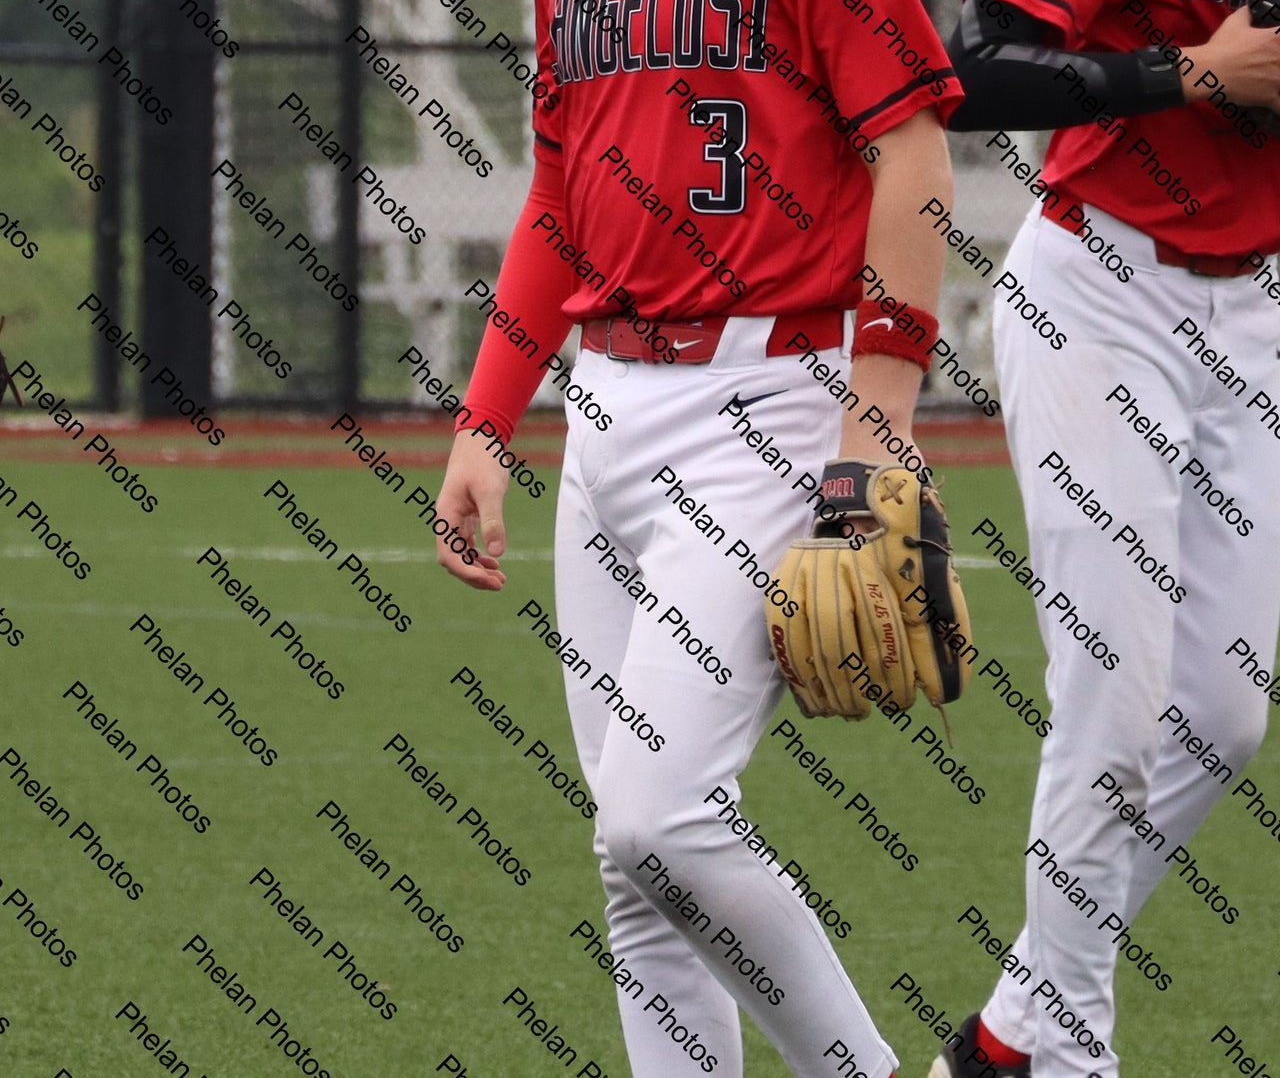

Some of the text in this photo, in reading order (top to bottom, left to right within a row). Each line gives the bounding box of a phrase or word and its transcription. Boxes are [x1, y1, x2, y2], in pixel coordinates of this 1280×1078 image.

[689, 99, 747, 213] 3
[866, 583, 899, 669] Psalms 37:24
